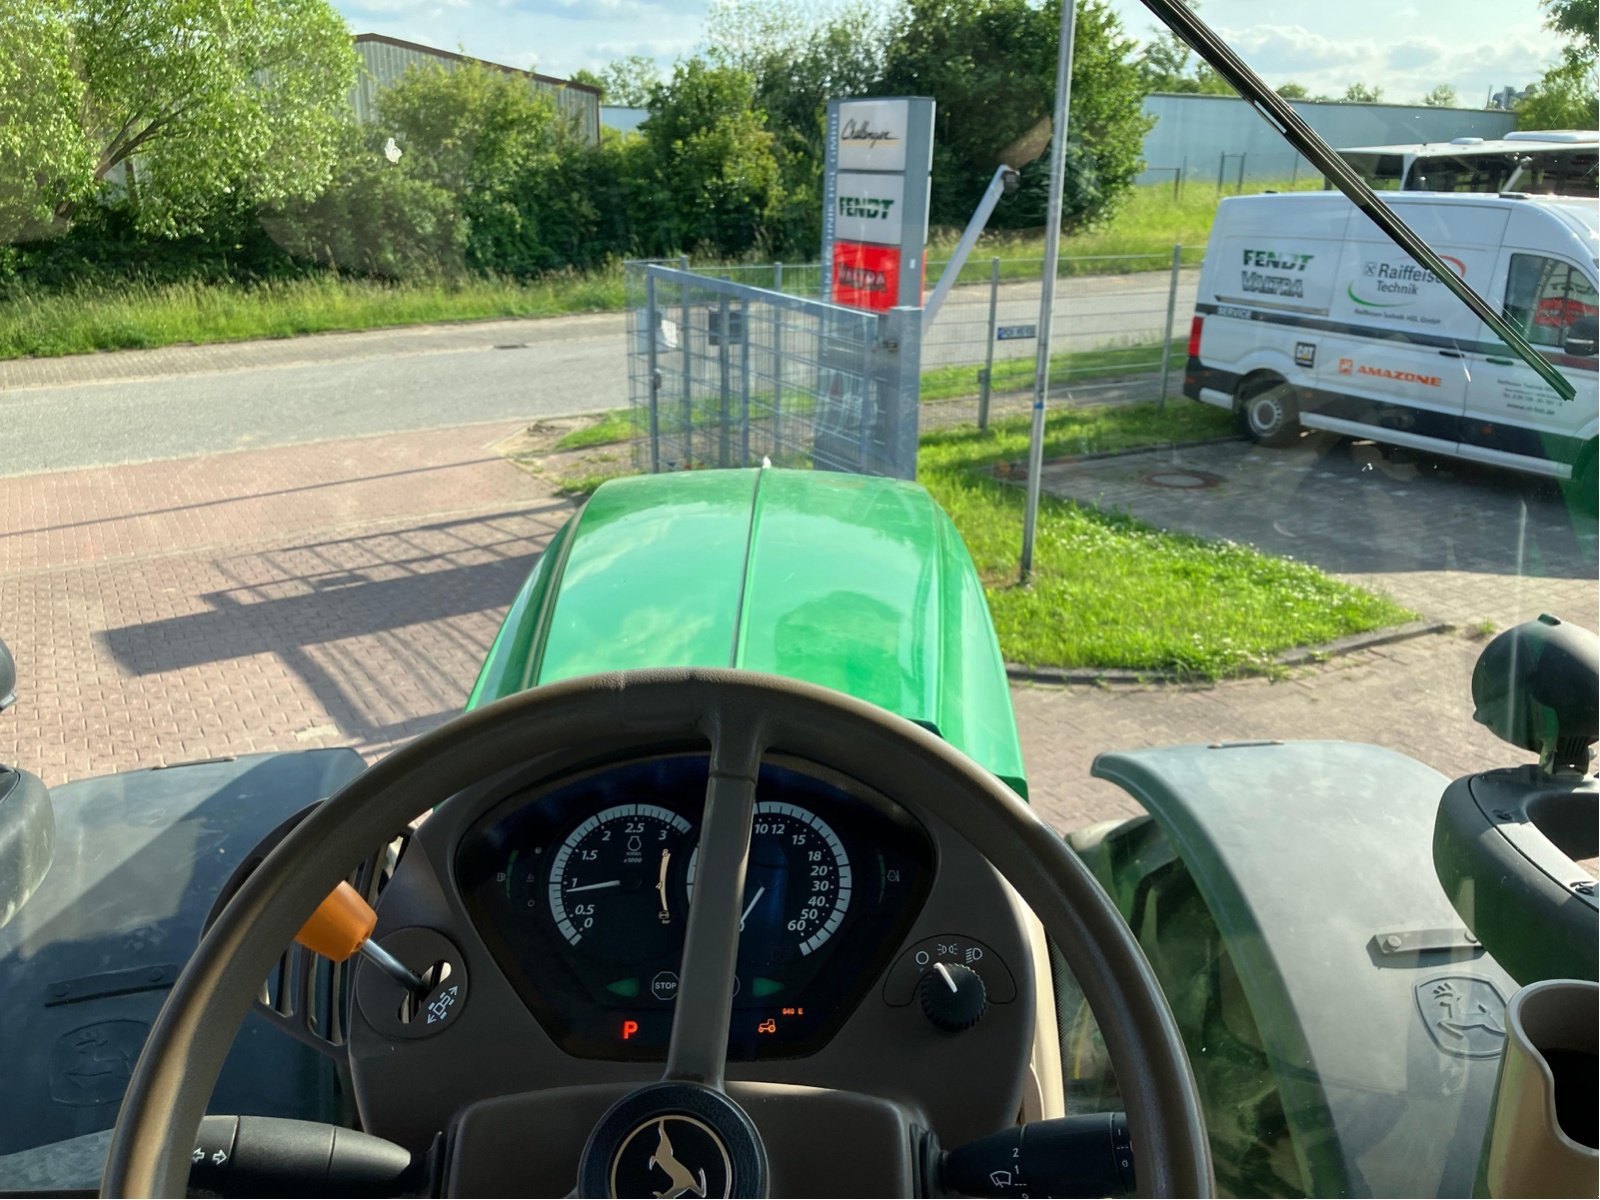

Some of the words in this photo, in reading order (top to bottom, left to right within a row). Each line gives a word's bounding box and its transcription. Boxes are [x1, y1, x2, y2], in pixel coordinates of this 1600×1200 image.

[839, 197, 894, 219] FENDT
[1243, 249, 1315, 271] FENDT
[1376, 280, 1418, 295] Technik
[1217, 305, 1252, 320] SERVICE
[1358, 366, 1442, 387] AMAZONE
[625, 822, 645, 833] 2.5
[754, 824, 768, 834] 10
[771, 824, 785, 834] 12
[602, 831, 611, 841] 2
[658, 830, 667, 840] 3
[792, 835, 806, 845] 15
[581, 850, 598, 860] 1.5
[808, 851, 822, 861] 18
[810, 865, 828, 876] 20
[572, 878, 578, 888] 1
[811, 881, 829, 891] 30
[808, 896, 826, 907] 40
[575, 904, 595, 915] 0.5
[800, 909, 818, 920] 50
[584, 917, 593, 928] 0
[787, 920, 806, 931] 60
[655, 982, 677, 990] STOP
[622, 1020, 638, 1040] P
[1012, 1148, 1020, 1158] 2
[1014, 1164, 1020, 1175] 1
